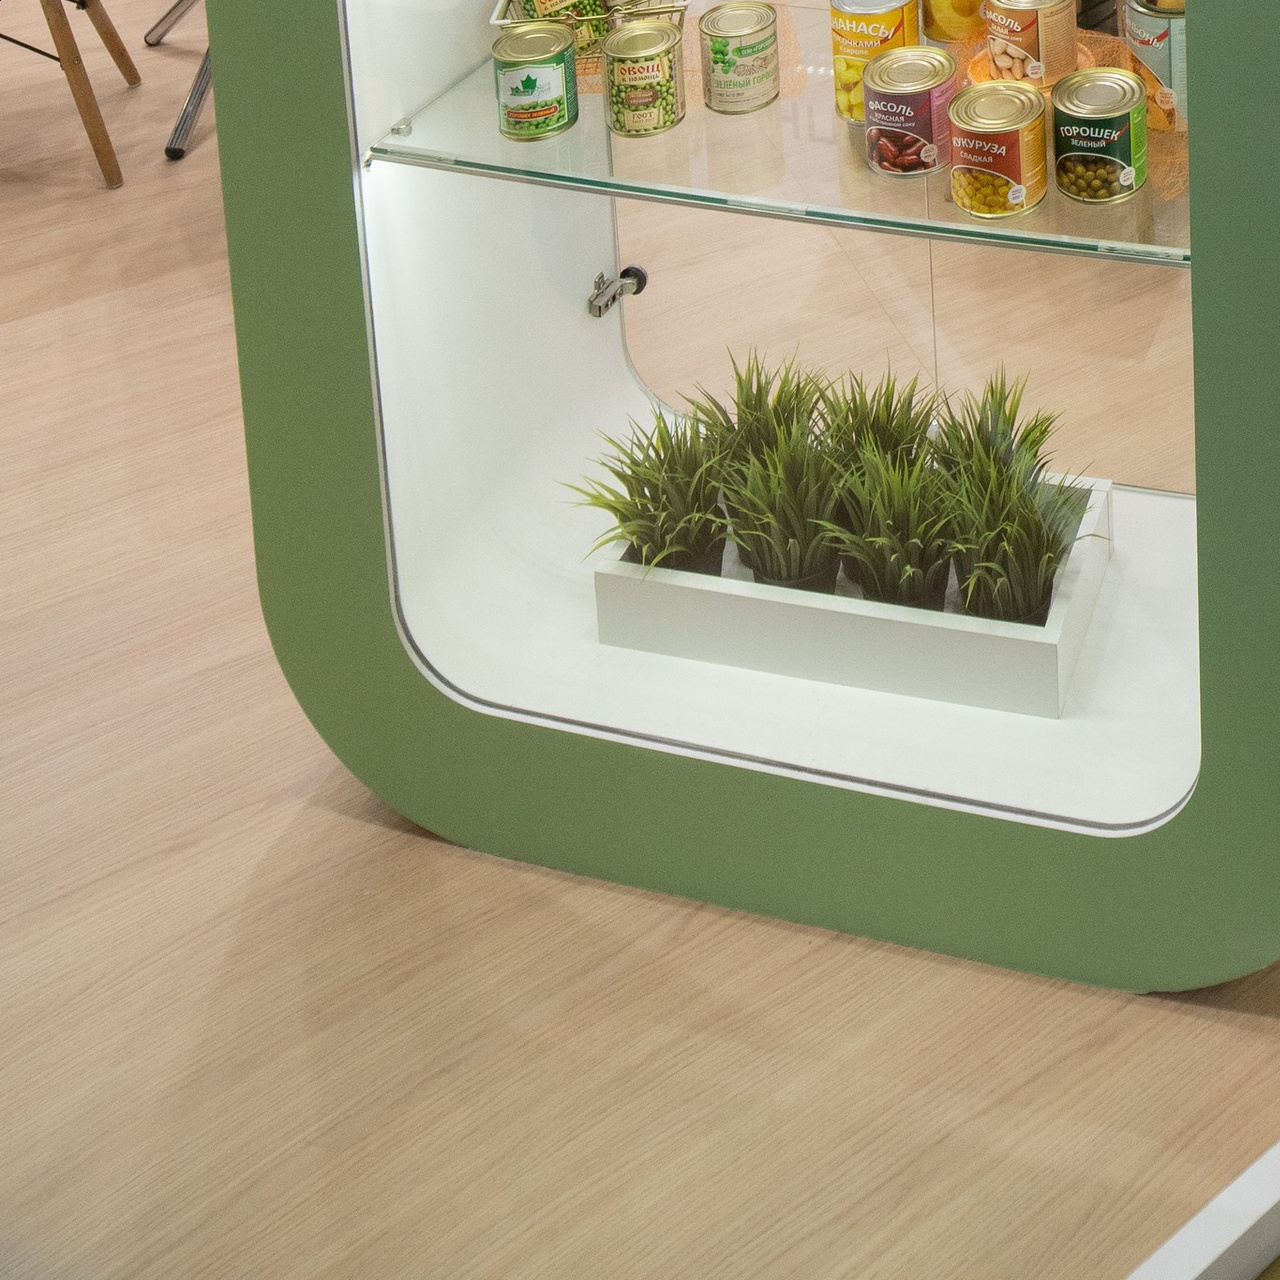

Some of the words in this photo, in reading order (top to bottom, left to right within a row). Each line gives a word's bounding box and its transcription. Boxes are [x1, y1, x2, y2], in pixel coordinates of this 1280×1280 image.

[832, 18, 895, 39] НАНАСЫ
[620, 64, 660, 76] ОВОЩ
[869, 101, 914, 117] ФАСОЛЬ
[1060, 126, 1121, 141] ГОРОШЕК
[953, 136, 1007, 156] КУКУРУЗА
[1071, 138, 1106, 148] ЗЕЛЕНЫЙ
[960, 151, 993, 163] СЛАДКАЯ
